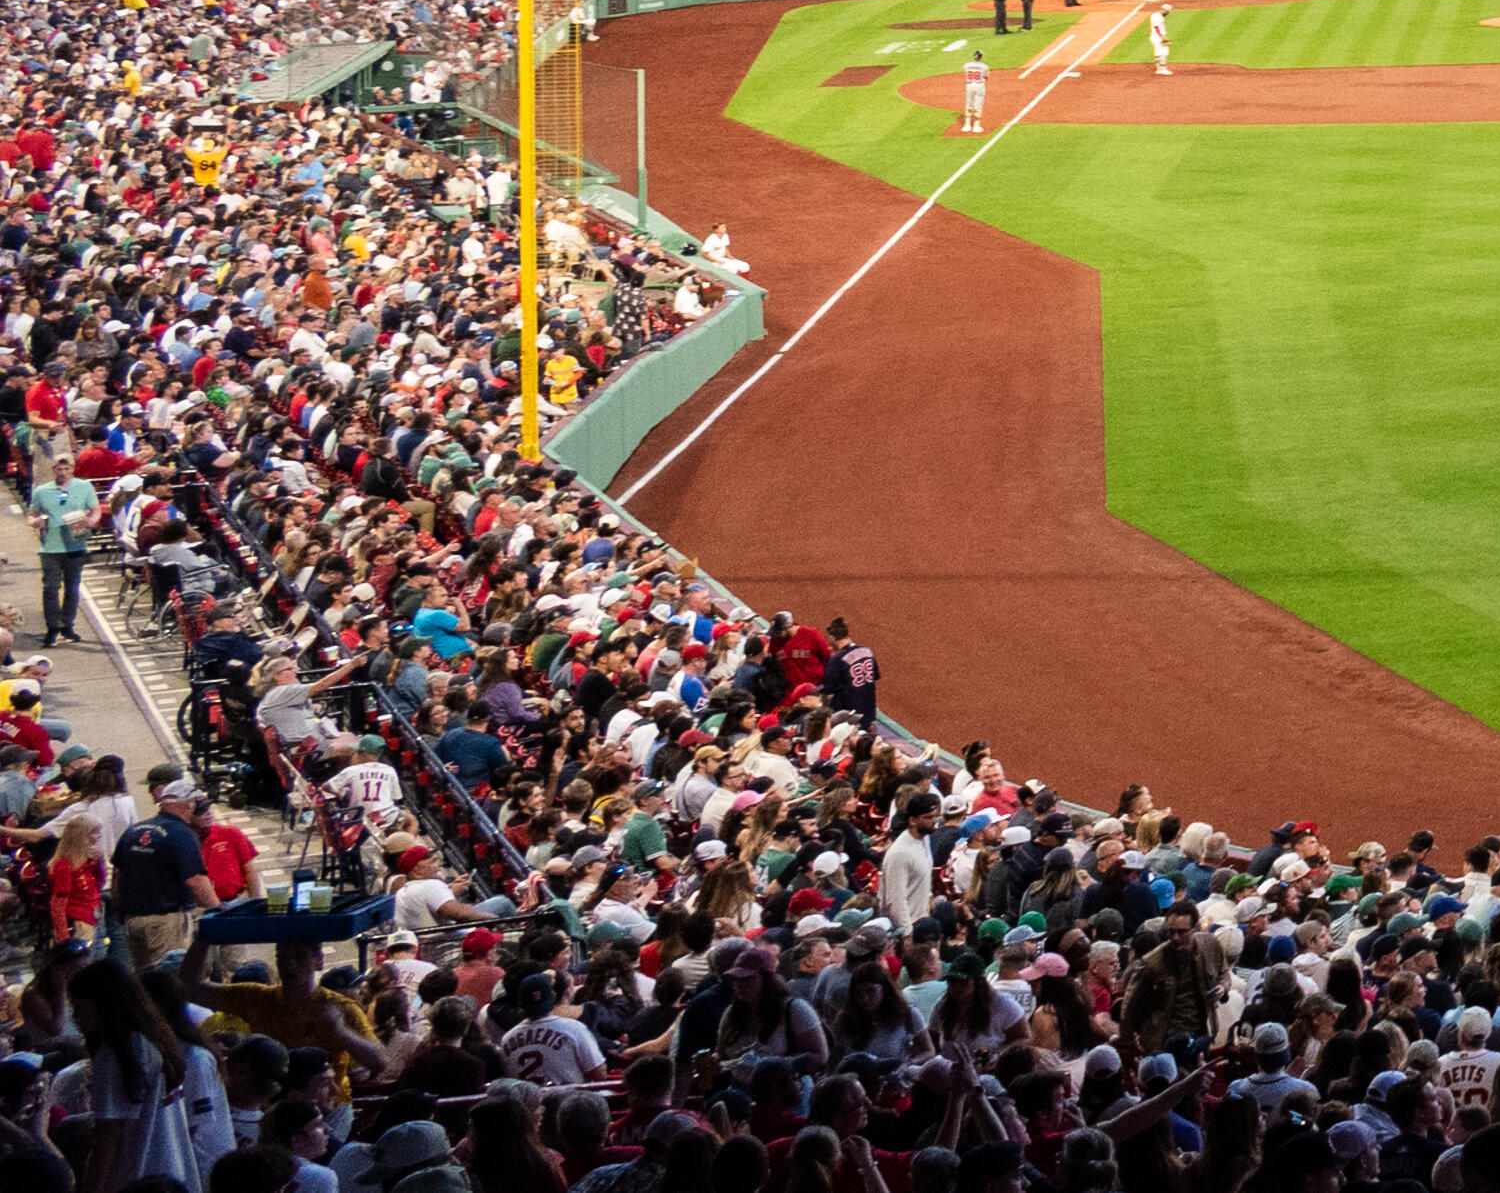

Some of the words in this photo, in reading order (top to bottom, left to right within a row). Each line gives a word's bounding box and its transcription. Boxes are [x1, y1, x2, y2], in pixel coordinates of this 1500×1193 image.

[362, 780, 383, 802] 11
[518, 1050, 545, 1080] 2
[1443, 1067, 1486, 1088] BETTS
